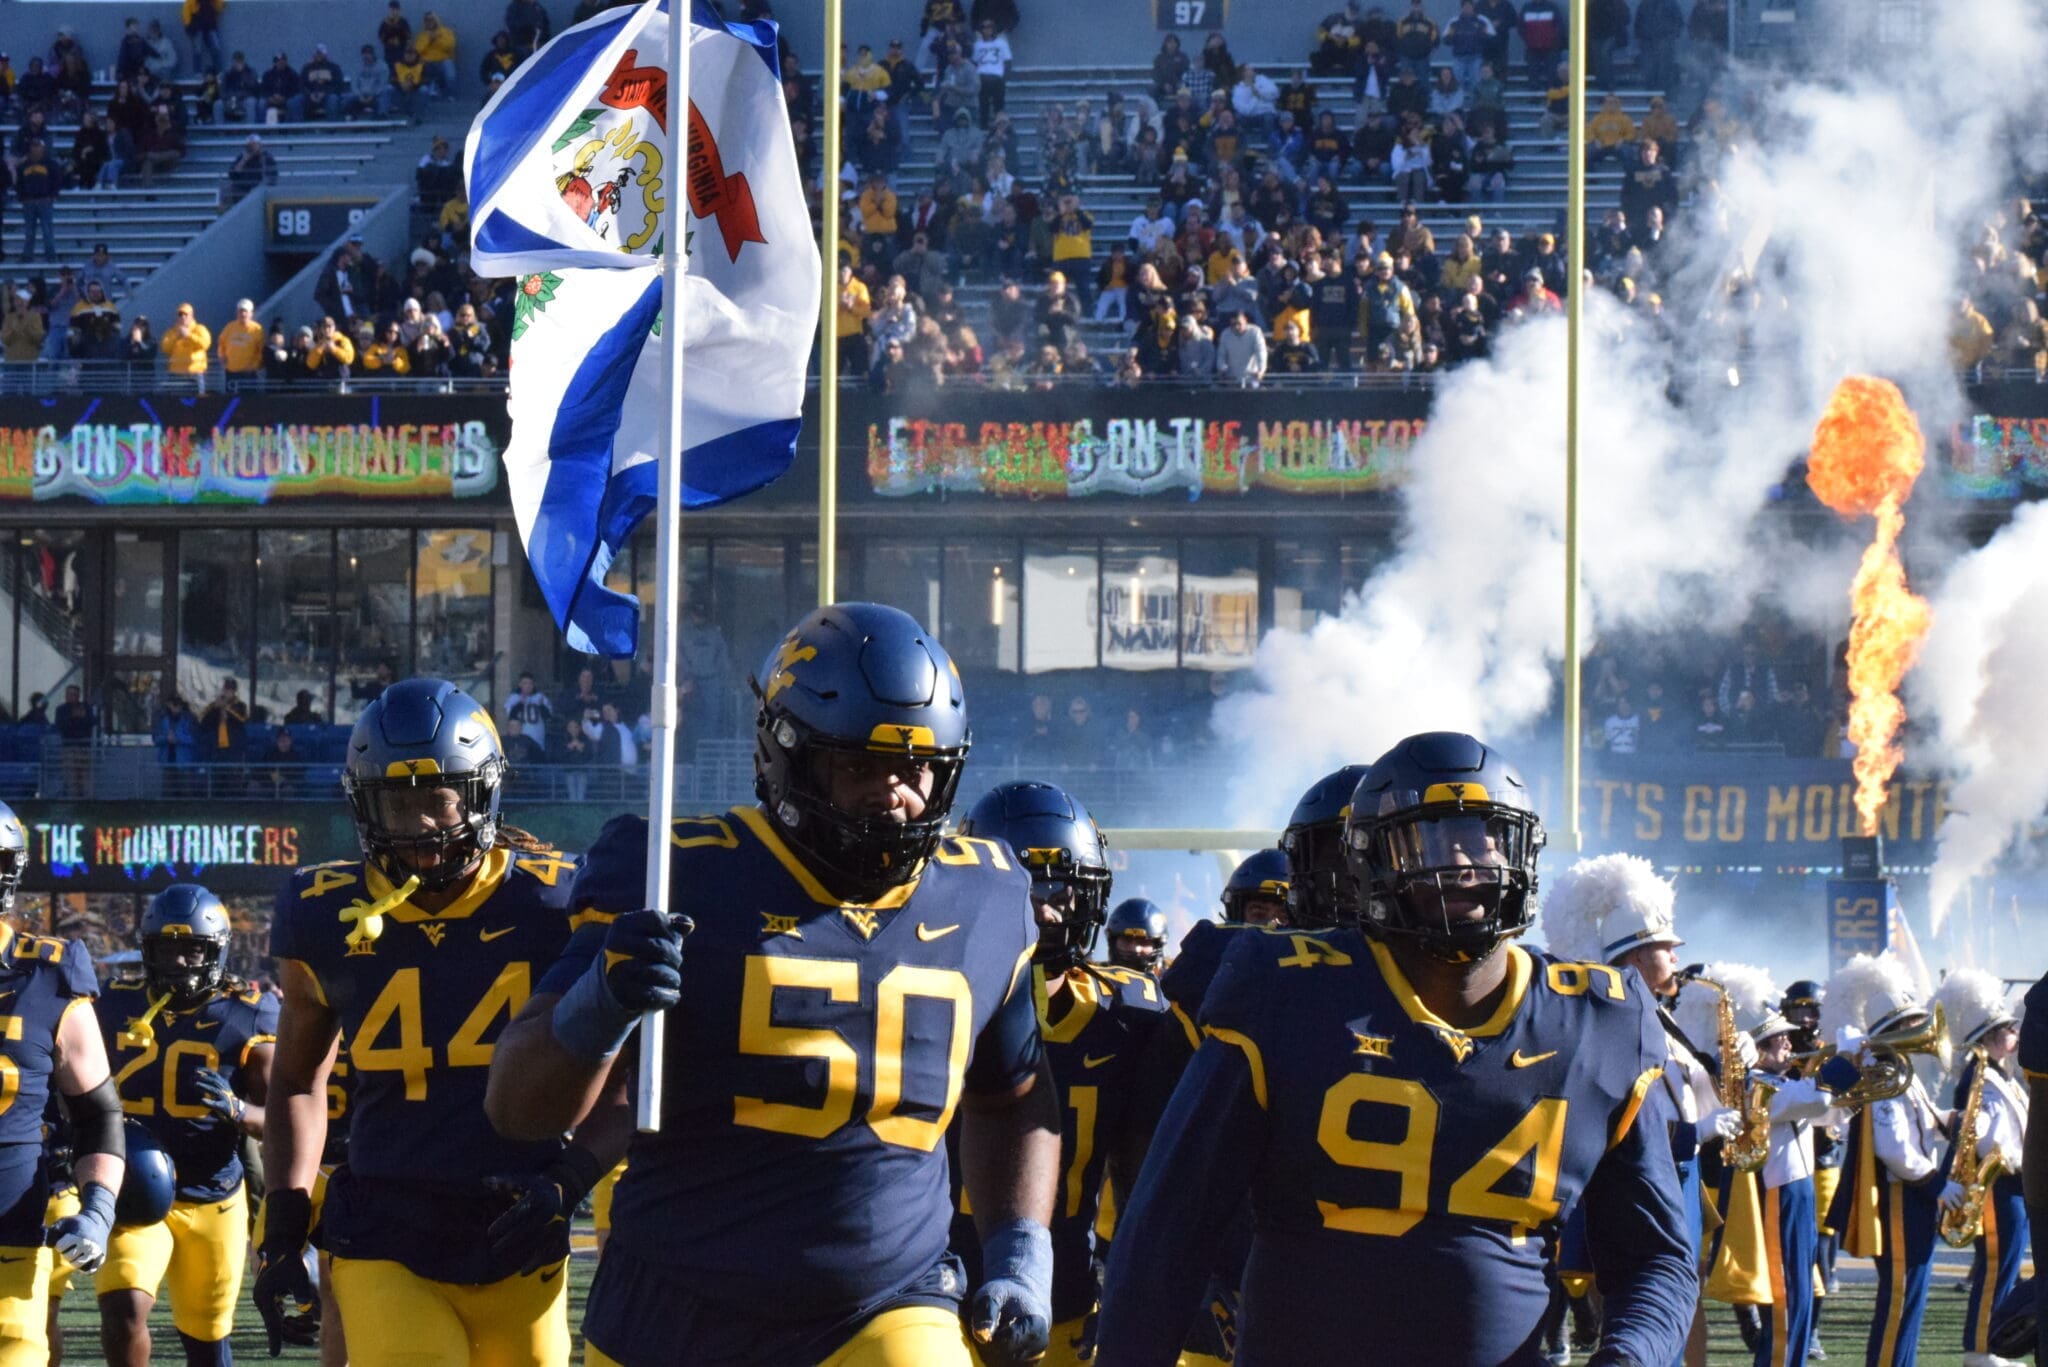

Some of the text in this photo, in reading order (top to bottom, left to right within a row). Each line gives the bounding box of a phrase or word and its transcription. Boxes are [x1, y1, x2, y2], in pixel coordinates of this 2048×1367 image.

[1174, 0, 1206, 25] 97
[278, 209, 311, 235] 98
[72, 423, 118, 476] ON
[130, 423, 199, 478] THE
[1107, 418, 1157, 471] ON
[1169, 418, 1242, 474] THE
[1683, 784, 1747, 843] GO
[35, 823, 85, 864] THE
[95, 824, 299, 866] MOUNTAINEERS
[350, 960, 532, 1101] 44
[733, 954, 973, 1153] 50
[114, 1031, 220, 1119] 20
[1316, 1072, 1570, 1247] 94
